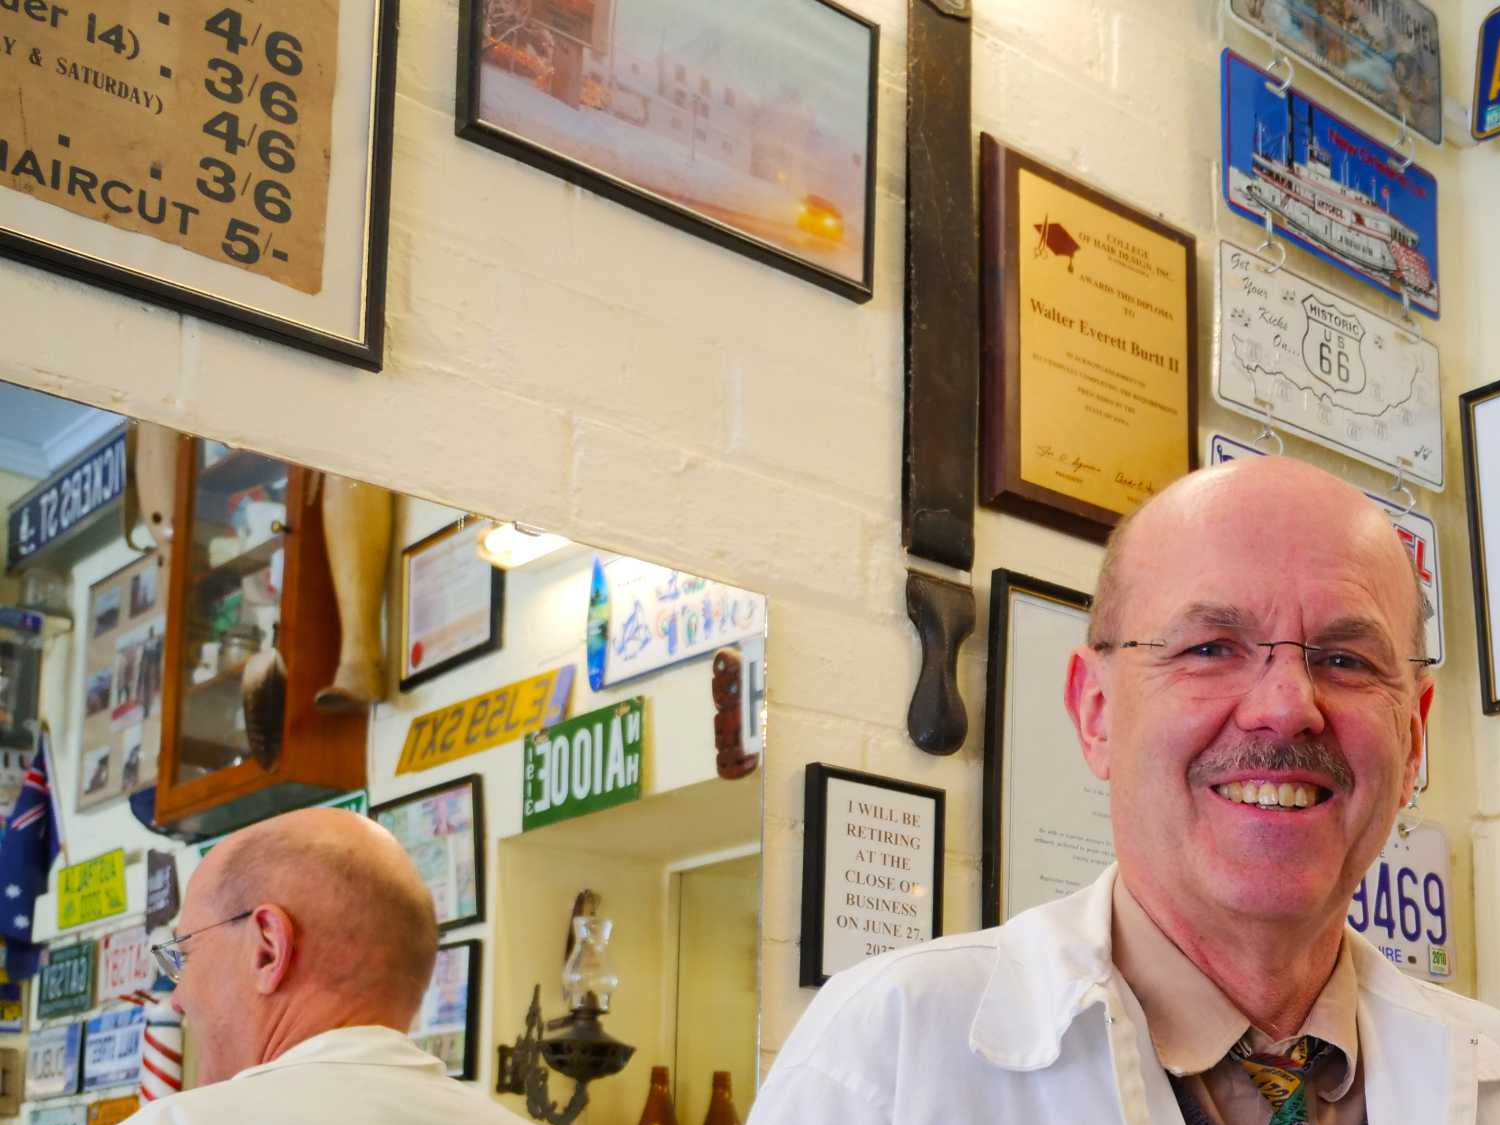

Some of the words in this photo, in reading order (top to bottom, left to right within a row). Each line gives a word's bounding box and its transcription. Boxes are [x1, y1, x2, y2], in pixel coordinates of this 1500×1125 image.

[204, 7, 304, 77] 4/6
[86, 12, 140, 60] 14)
[204, 58, 299, 126] 3/6
[29, 47, 42, 67] &
[56, 57, 163, 115] SATURDAY)
[202, 111, 296, 174] 4/6
[196, 157, 292, 224] 3/6
[1309, 303, 1360, 337] HISTORIC
[1030, 298, 1075, 331] Walter
[1080, 320, 1127, 353] Everett
[1130, 341, 1165, 368] Burtt
[1168, 357, 1179, 374] II
[1319, 342, 1350, 383] 66
[848, 800, 853, 814] I
[857, 802, 898, 823] WILL
[902, 812, 920, 828] BE
[846, 823, 920, 850] RETIRING
[856, 850, 876, 864] AT
[880, 853, 911, 871] THE
[845, 869, 896, 891] CLOSE
[846, 893, 917, 918] BUSINESS
[836, 914, 858, 930] ON
[863, 917, 900, 940] JUNE
[906, 926, 924, 942] 27,
[865, 943, 896, 956] 20
